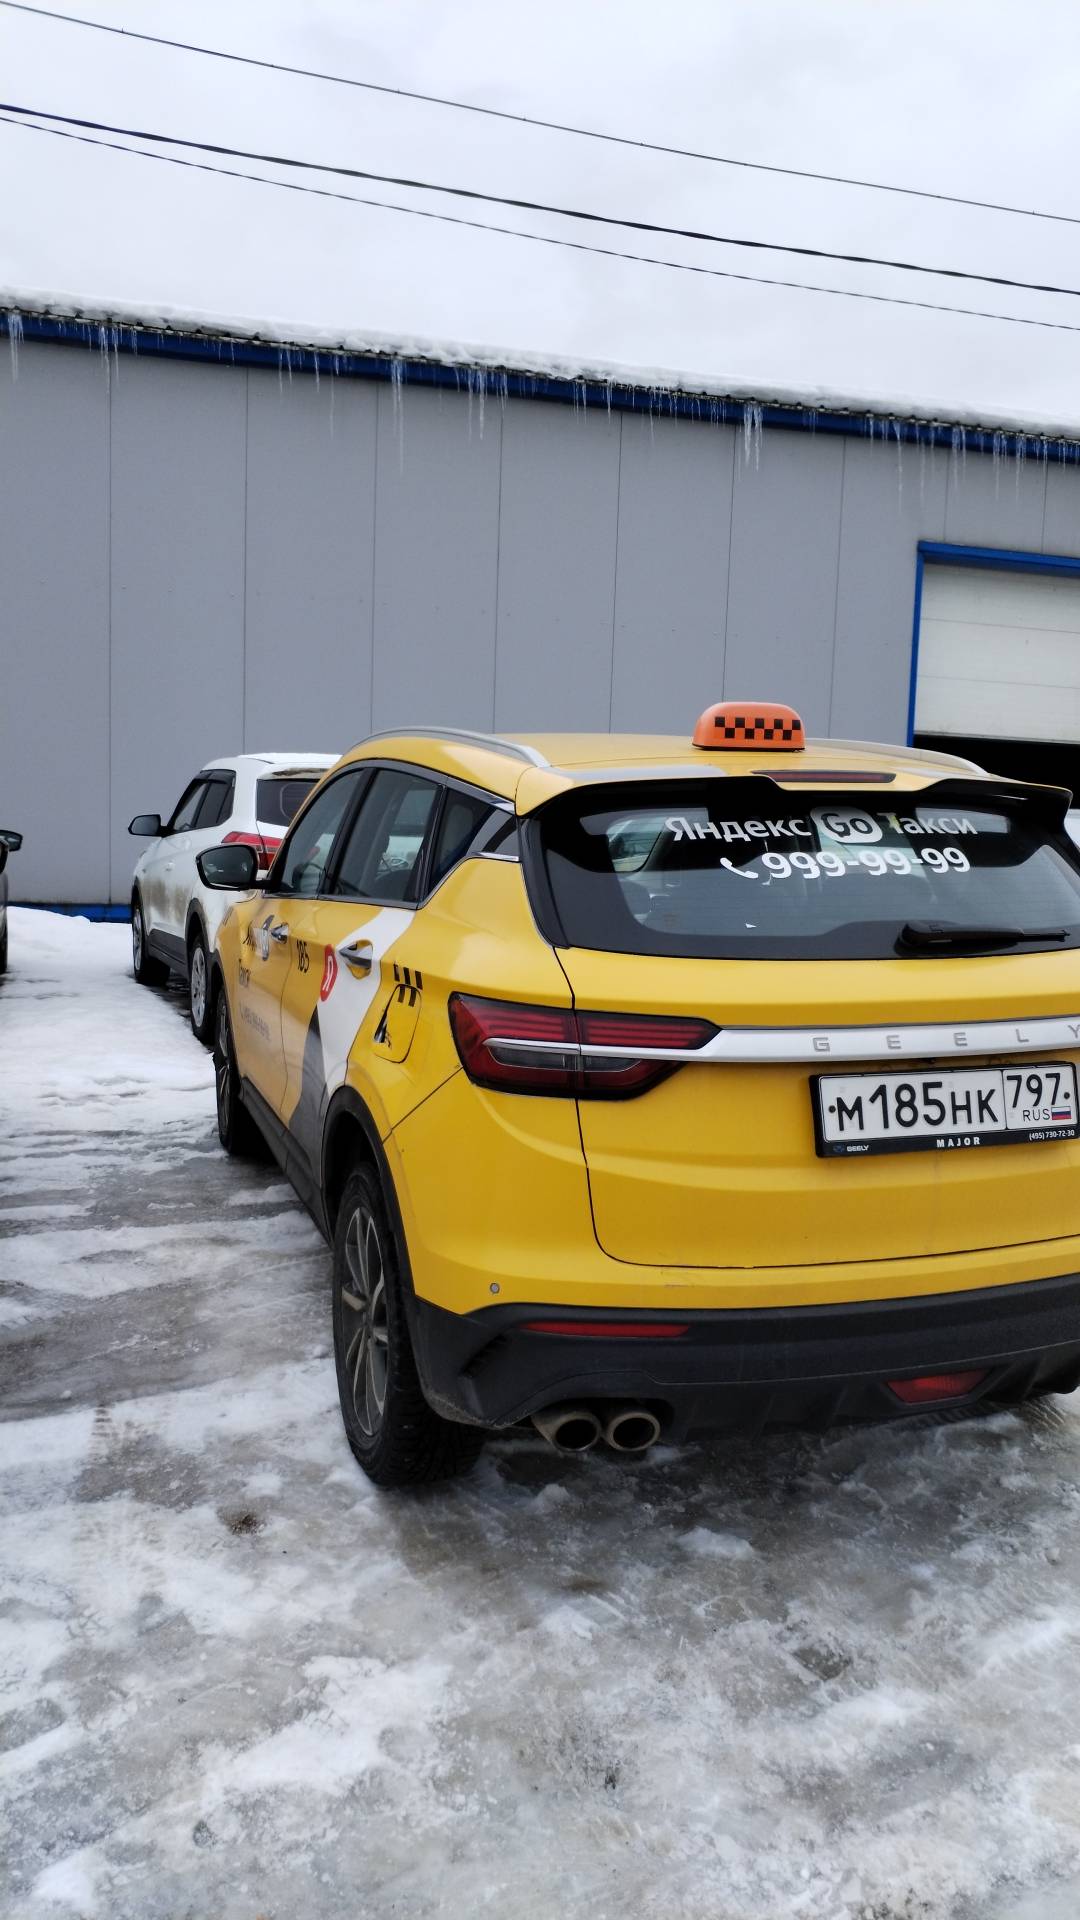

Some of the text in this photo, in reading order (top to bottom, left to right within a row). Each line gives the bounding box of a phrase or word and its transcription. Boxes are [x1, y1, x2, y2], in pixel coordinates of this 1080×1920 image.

[664, 811, 978, 843] Яндекс Go Такси
[761, 847, 971, 879] 999-99-99
[296, 938, 310, 974] 185
[812, 1024, 1080, 1052] GEELY
[1006, 1072, 1061, 1109] 797
[1022, 1108, 1051, 1122] RUS
[846, 1129, 1075, 1153] GEELY MAJOR (495) 730-72-30
